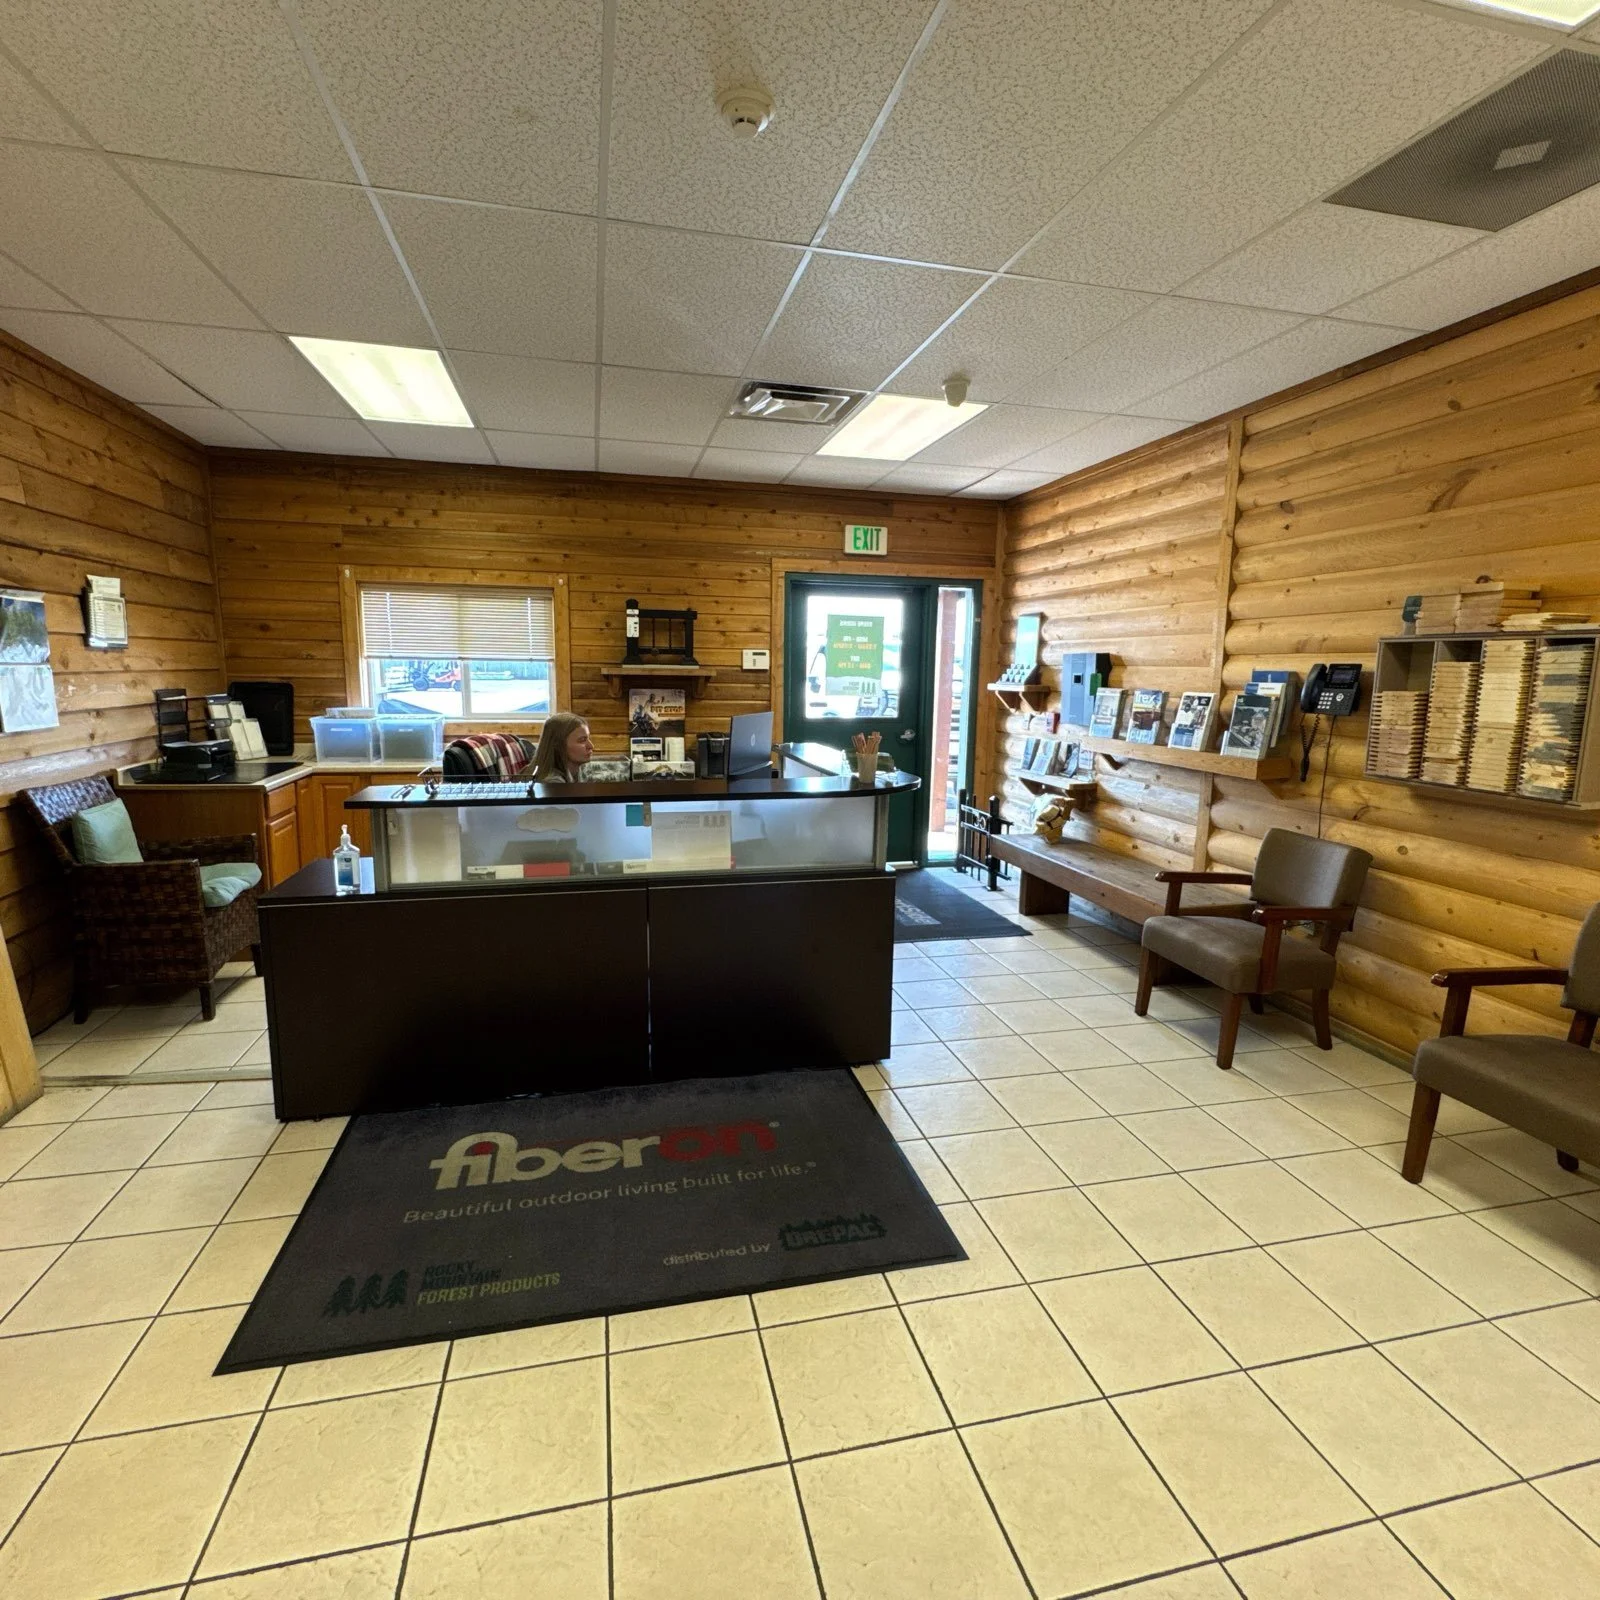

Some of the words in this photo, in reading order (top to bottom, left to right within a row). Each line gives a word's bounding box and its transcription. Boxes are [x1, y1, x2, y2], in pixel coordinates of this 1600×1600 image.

[853, 527, 882, 551] EXIT
[403, 1198, 511, 1223] Beautiful
[519, 1190, 614, 1209] outdoor
[618, 1180, 678, 1197] living
[683, 1173, 732, 1189] built
[737, 1168, 768, 1182] for
[663, 1245, 747, 1266] distributed
[750, 1243, 770, 1253] by
[425, 1260, 474, 1277] ROCKY
[417, 1286, 478, 1305] FOREST
[479, 1272, 561, 1297] PRODUCTS
